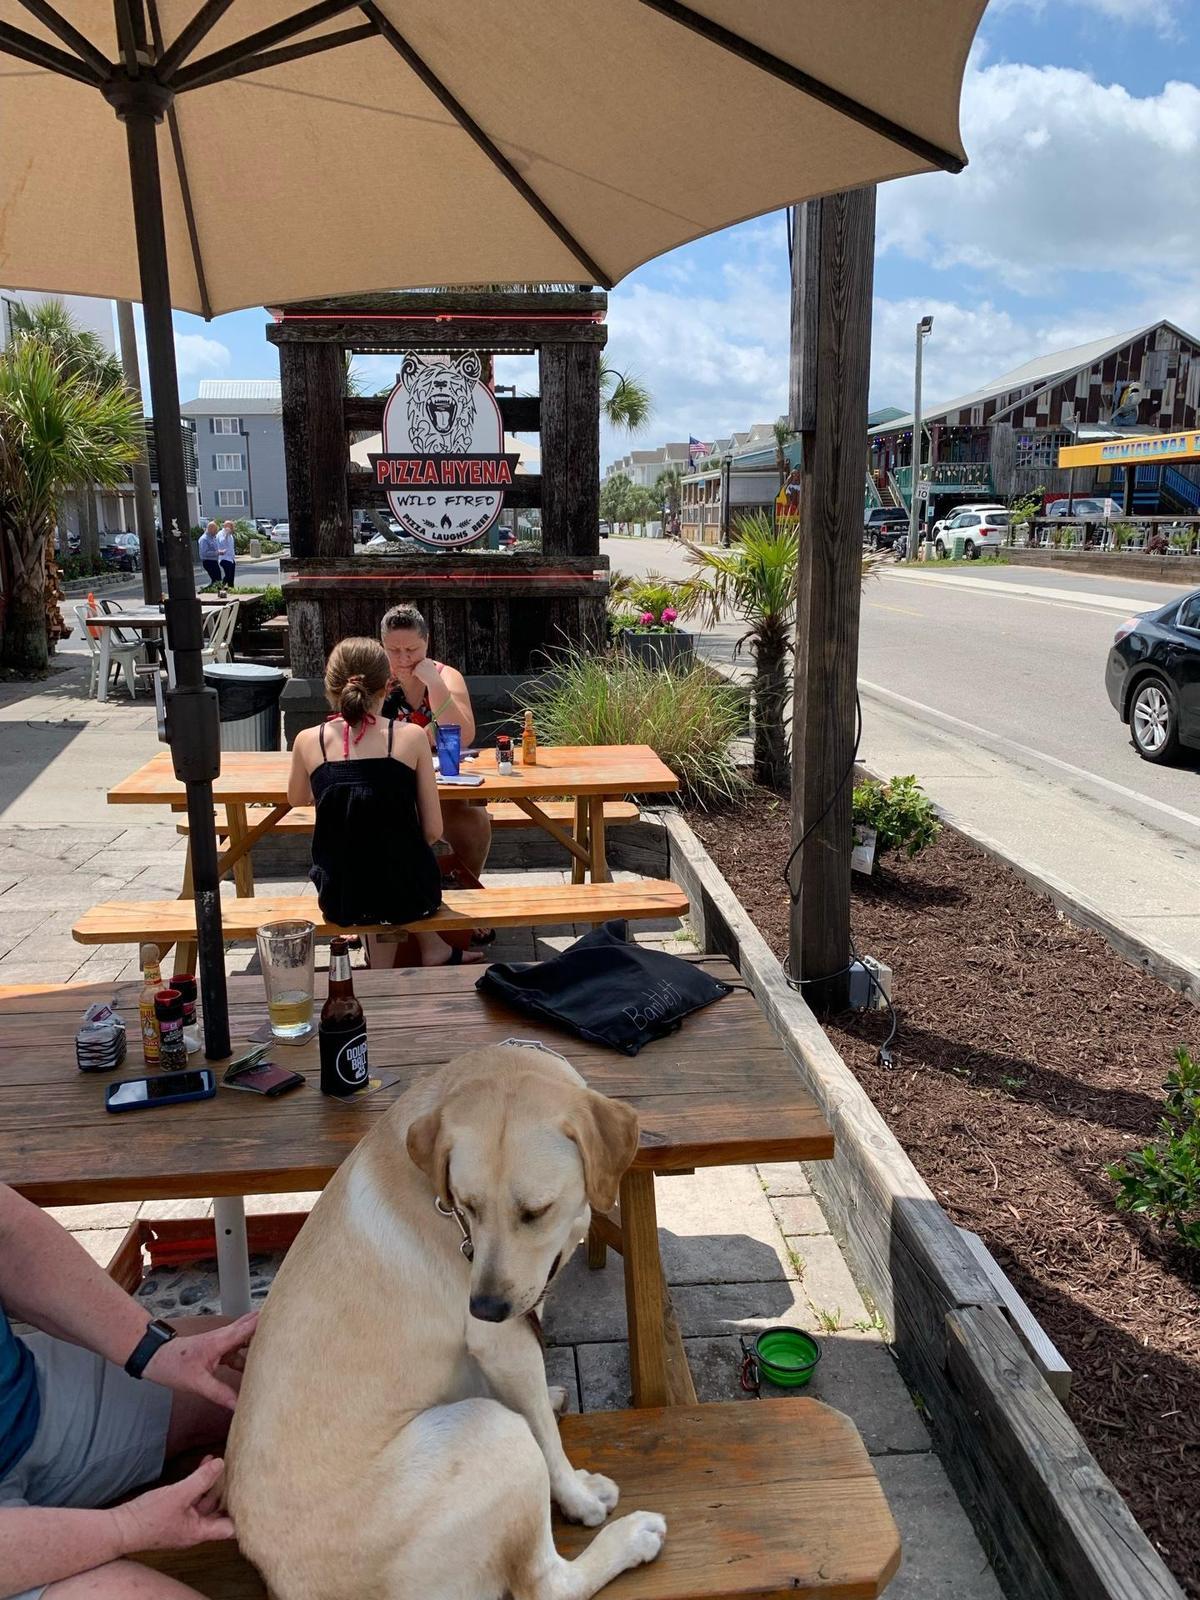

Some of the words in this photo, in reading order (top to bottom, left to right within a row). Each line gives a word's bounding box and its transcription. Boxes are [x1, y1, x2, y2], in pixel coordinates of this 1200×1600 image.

[376, 460, 440, 484] PIZZA
[440, 460, 512, 484] HYENA
[397, 494, 437, 507] WILD
[445, 495, 495, 507] FIRED
[918, 490, 928, 499] 10
[402, 513, 426, 535] PIZZA
[431, 531, 468, 541] LAUGHS
[471, 513, 490, 532] BEER
[622, 979, 682, 1031] Bartlett
